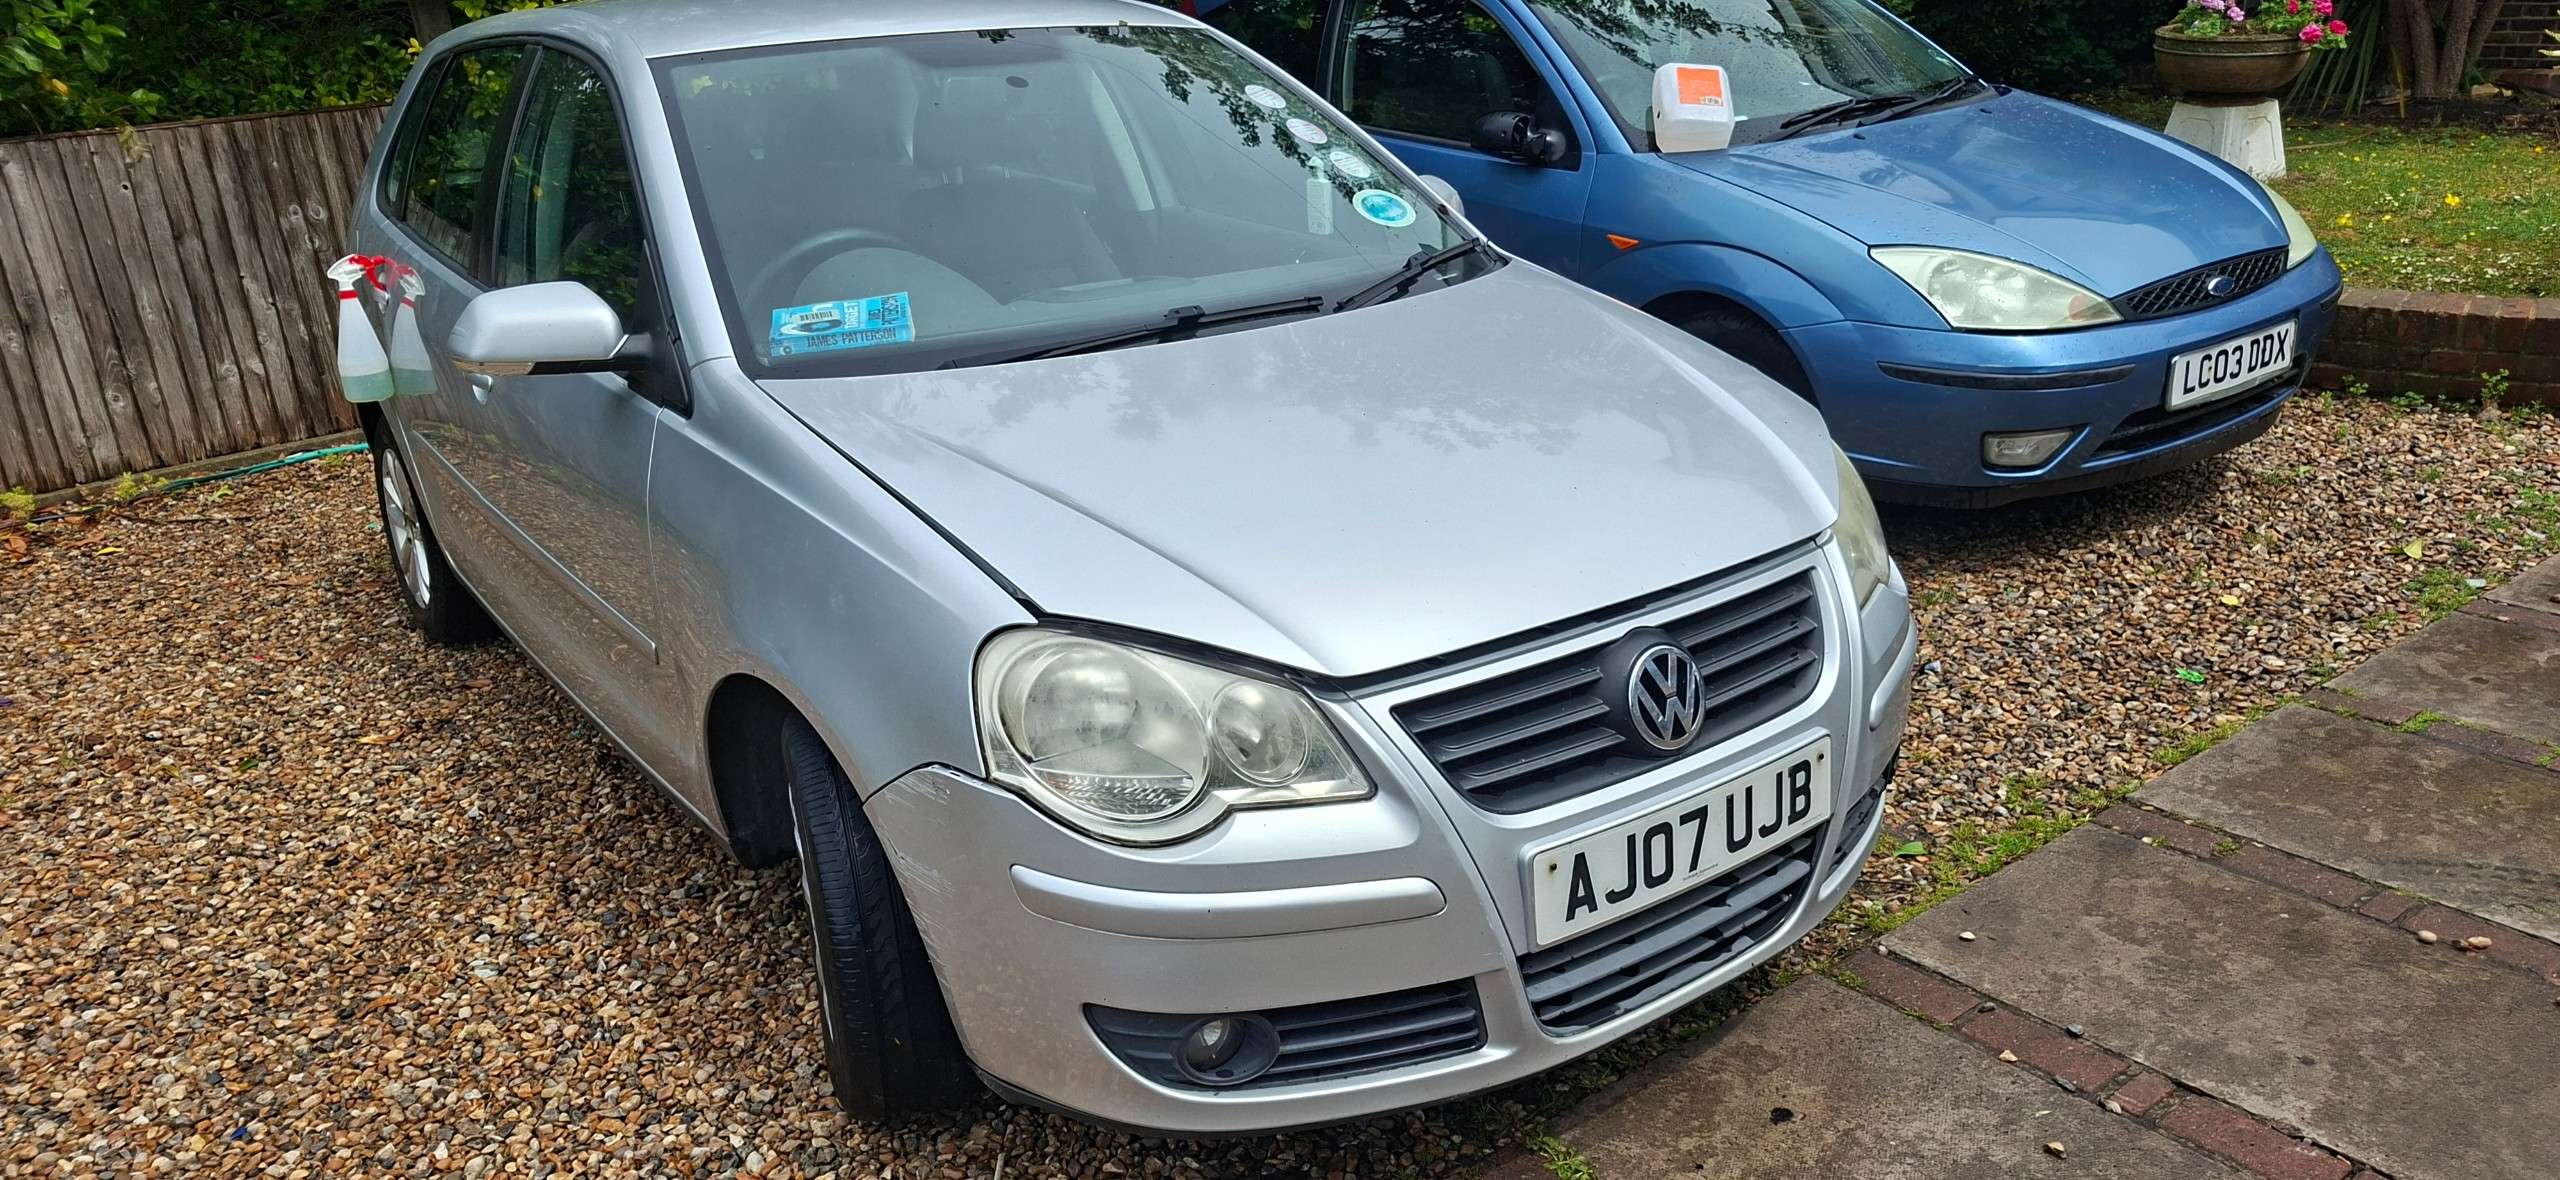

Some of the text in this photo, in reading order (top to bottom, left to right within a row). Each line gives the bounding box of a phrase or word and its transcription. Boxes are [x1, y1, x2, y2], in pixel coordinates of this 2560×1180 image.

[808, 328, 896, 347] JAMES PATTERSON
[2182, 328, 2288, 395] LC03 DDX
[1630, 647, 1702, 747] VW
[1565, 759, 1811, 922] AJ07 UJB
